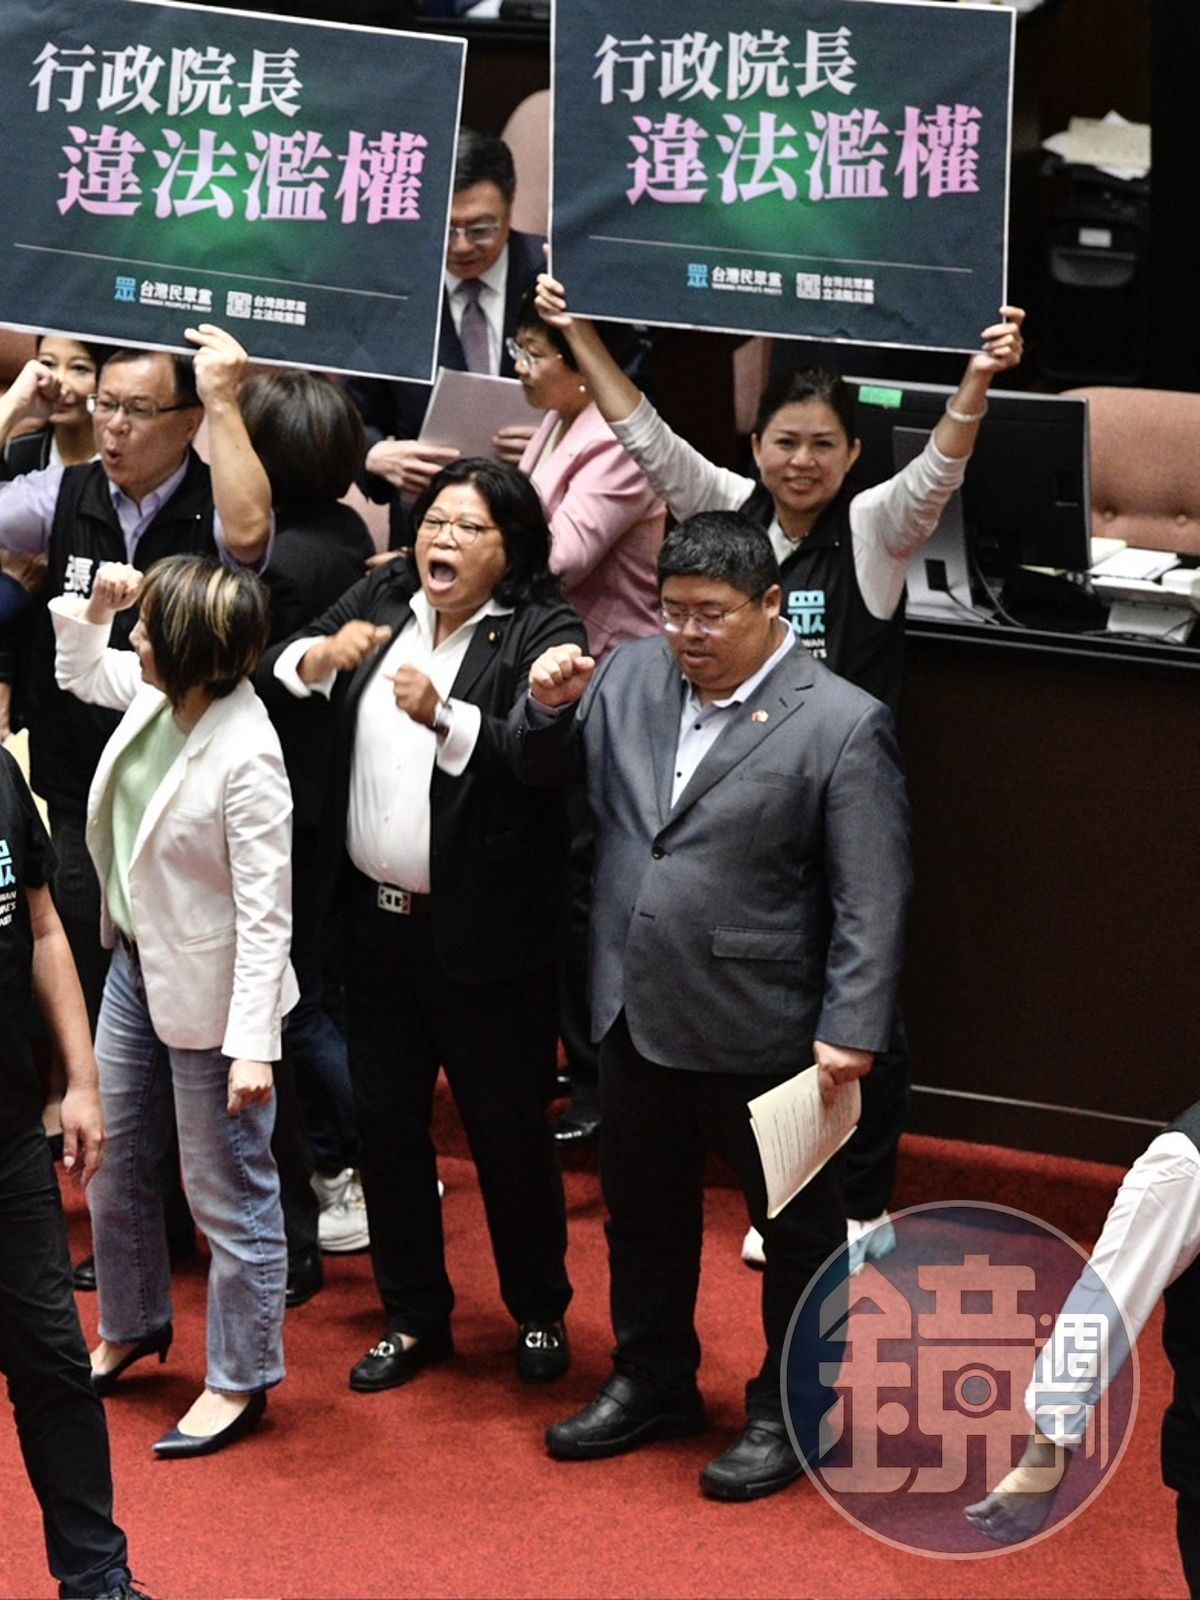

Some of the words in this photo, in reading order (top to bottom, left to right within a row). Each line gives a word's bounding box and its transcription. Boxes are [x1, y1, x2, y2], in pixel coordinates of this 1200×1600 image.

[29, 42, 303, 117] 行政院長
[593, 26, 857, 104] 行政院長
[56, 125, 428, 224] 違法濫權
[626, 104, 983, 205] 違法濫權
